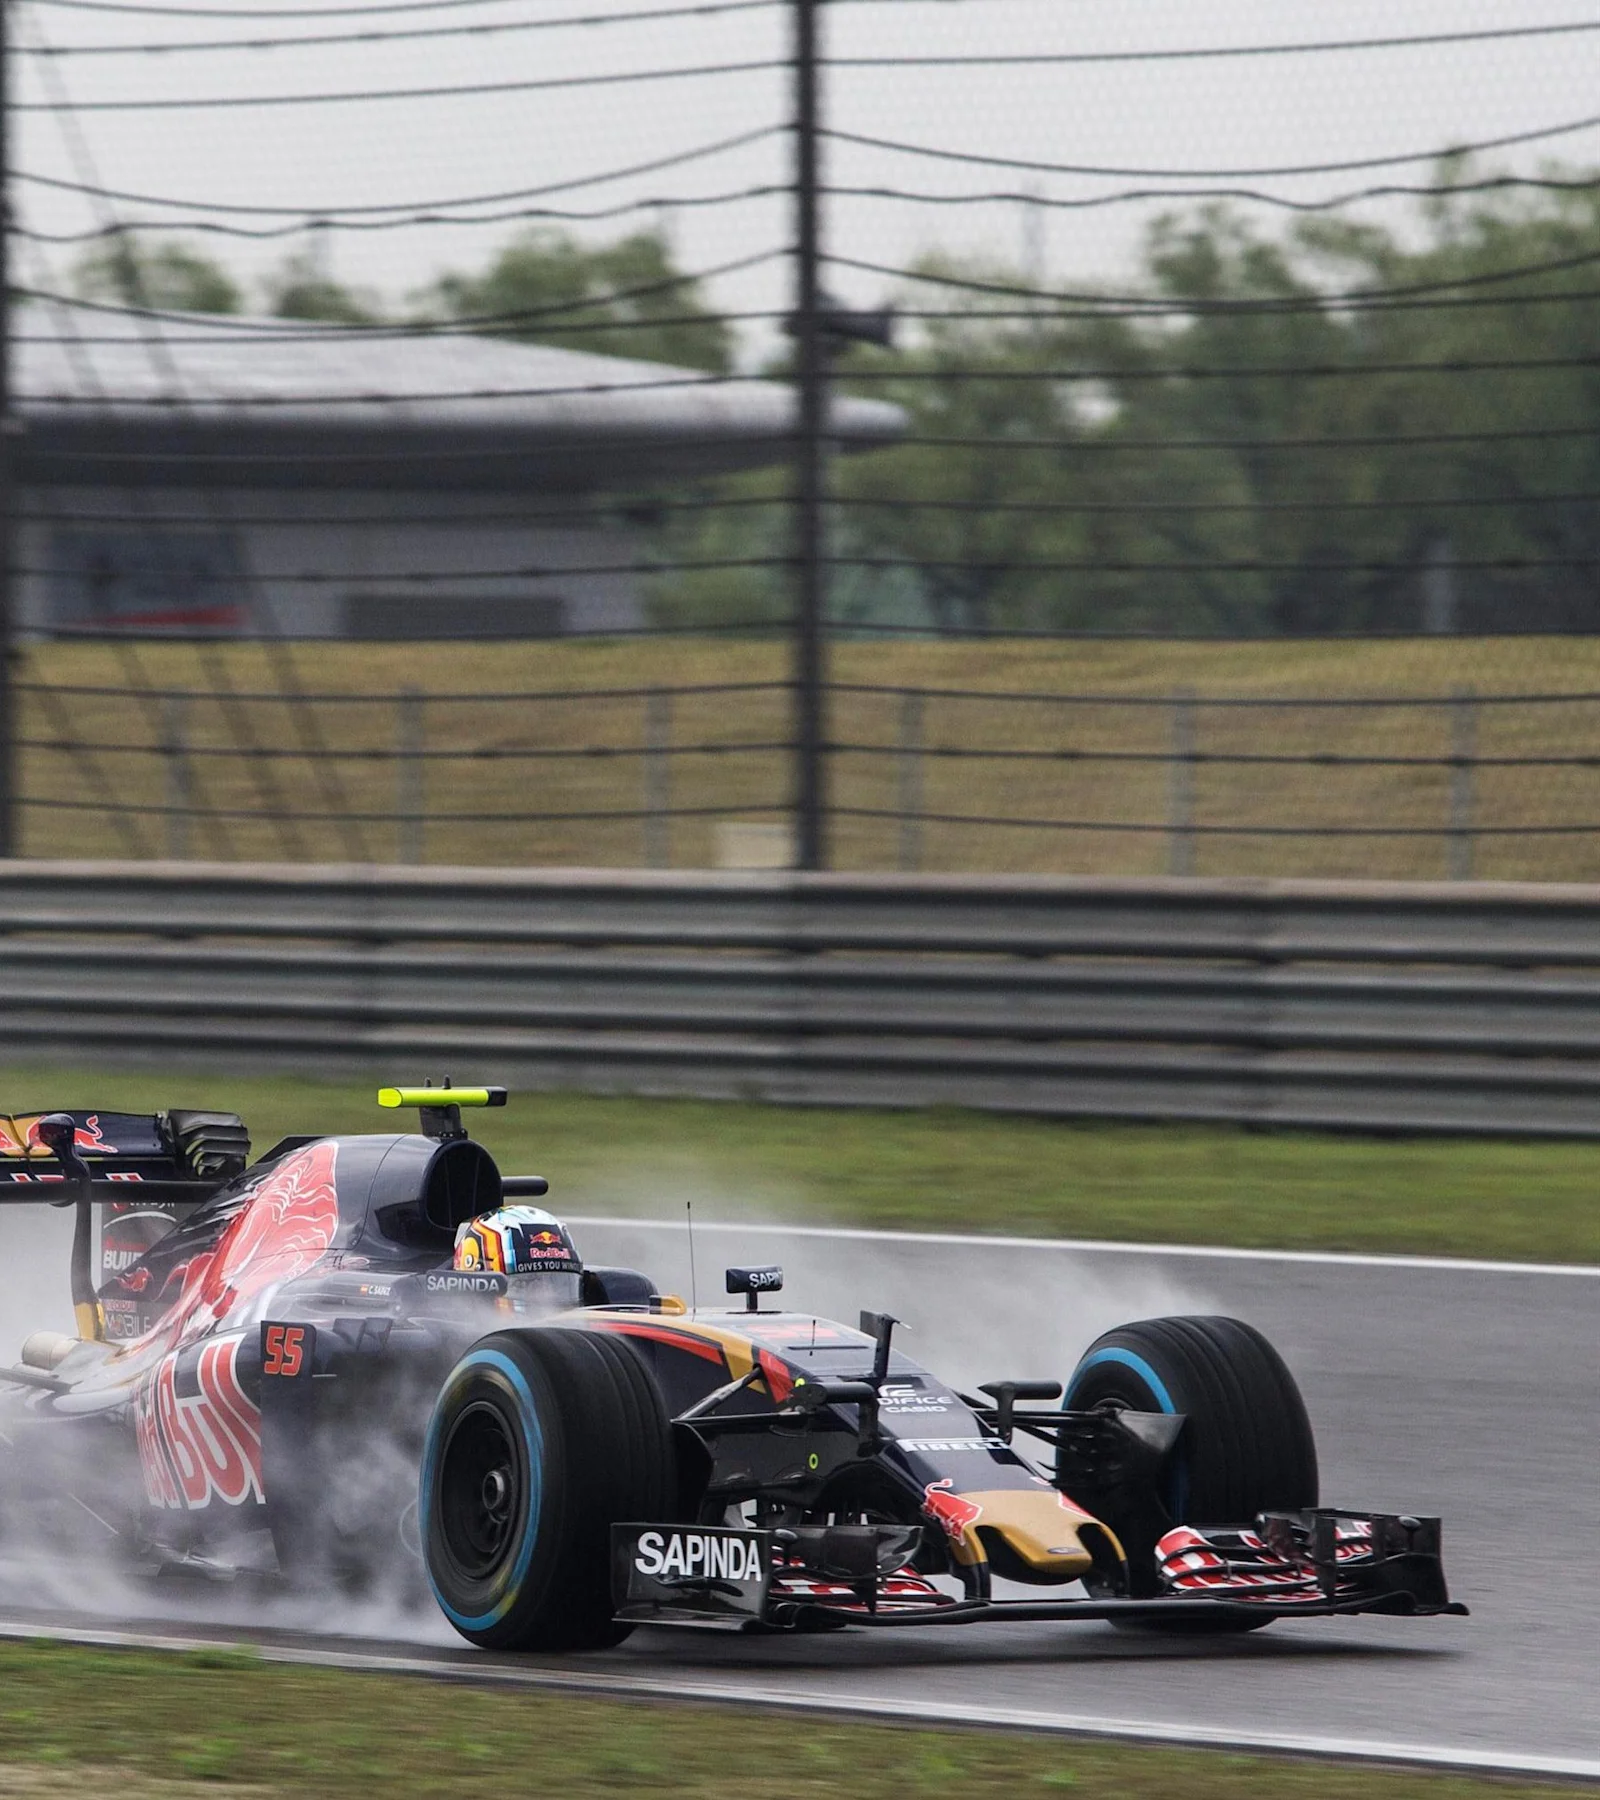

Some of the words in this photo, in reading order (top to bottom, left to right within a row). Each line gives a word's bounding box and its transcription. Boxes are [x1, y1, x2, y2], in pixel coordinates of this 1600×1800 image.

[518, 1262, 542, 1272] GIVES
[544, 1261, 560, 1270] YOU
[427, 1276, 500, 1292] SAPINDA
[264, 1326, 304, 1376] 55
[877, 1396, 954, 1406] DIFICE
[884, 1405, 948, 1413] CASIO
[635, 1531, 762, 1582] SAPINDA
